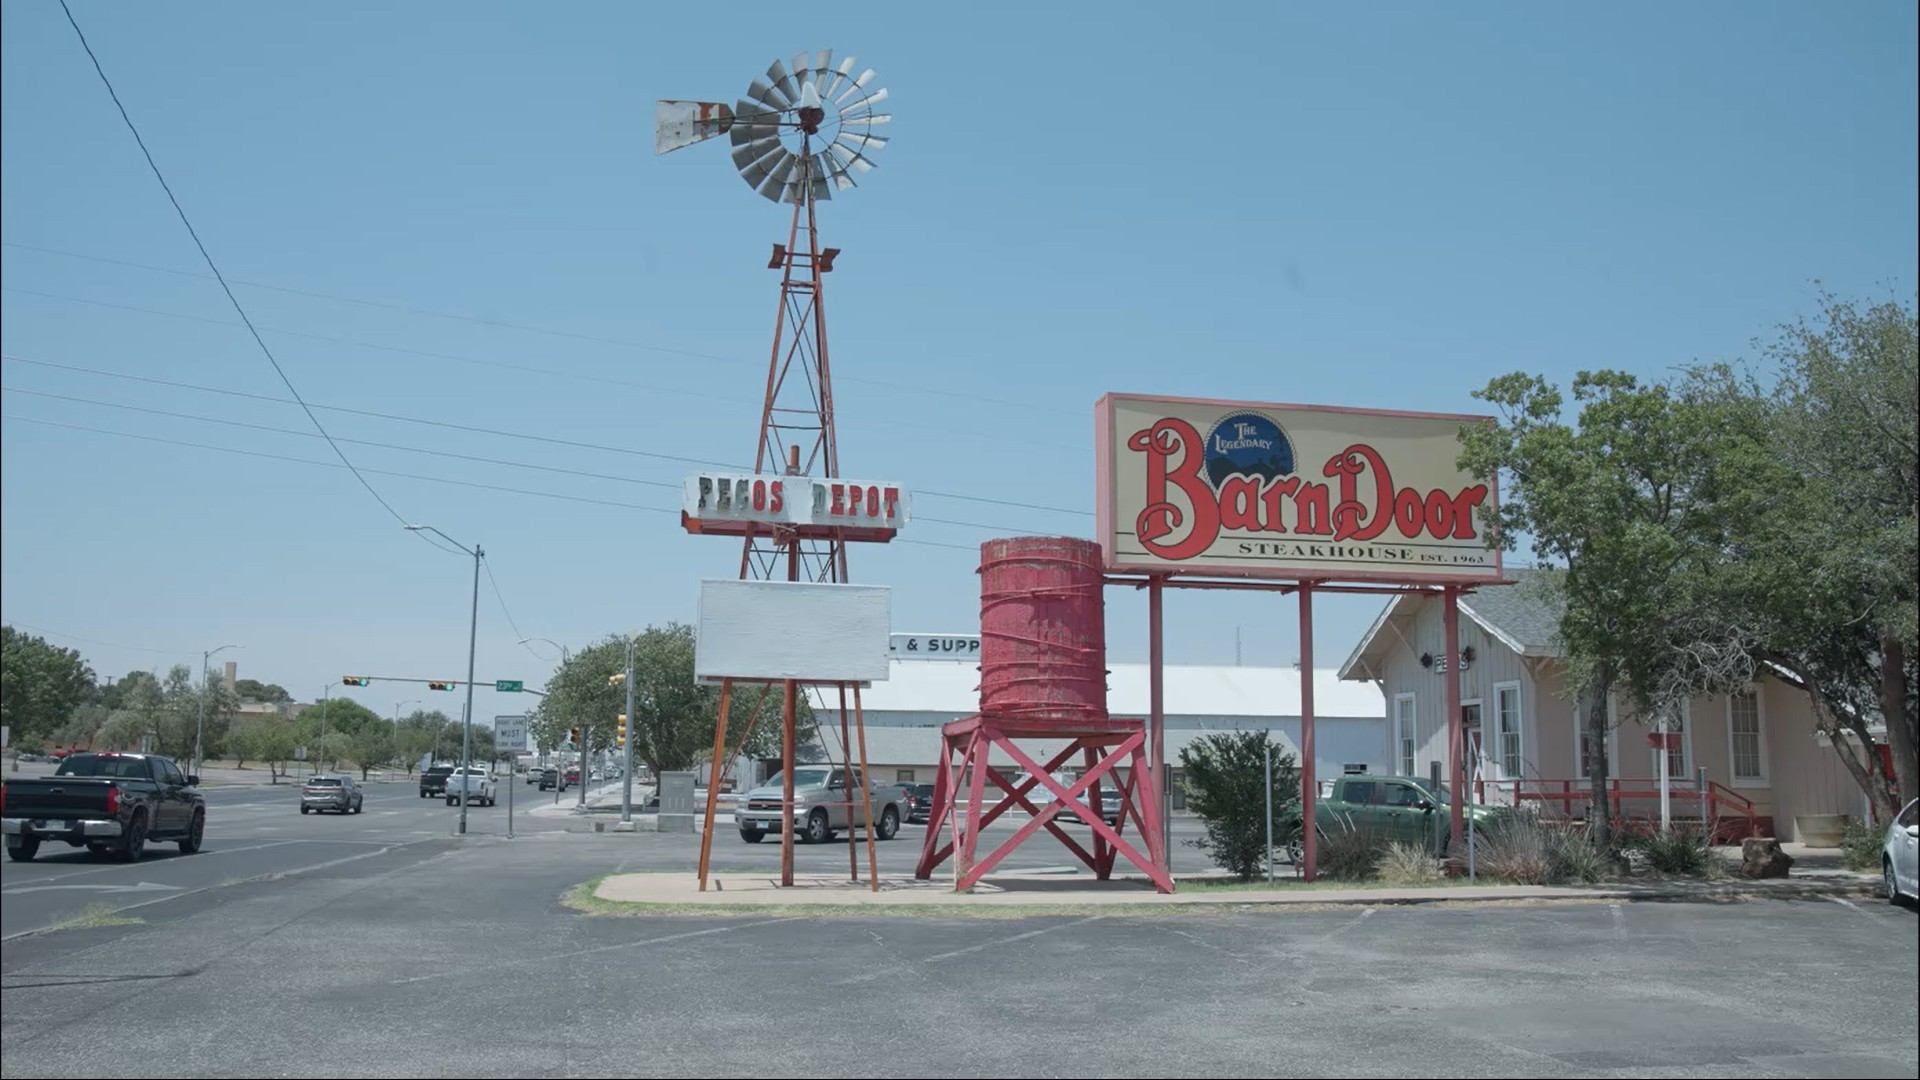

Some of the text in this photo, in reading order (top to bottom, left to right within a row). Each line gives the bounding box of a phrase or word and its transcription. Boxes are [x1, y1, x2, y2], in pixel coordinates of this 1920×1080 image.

[1234, 422, 1257, 440] THE
[1215, 434, 1272, 454] LEGENDARY
[698, 476, 899, 518] PECOS DEPOT
[1239, 543, 1413, 560] STEAKHOUSE
[1421, 554, 1448, 562] EST.
[907, 638, 918, 651] &
